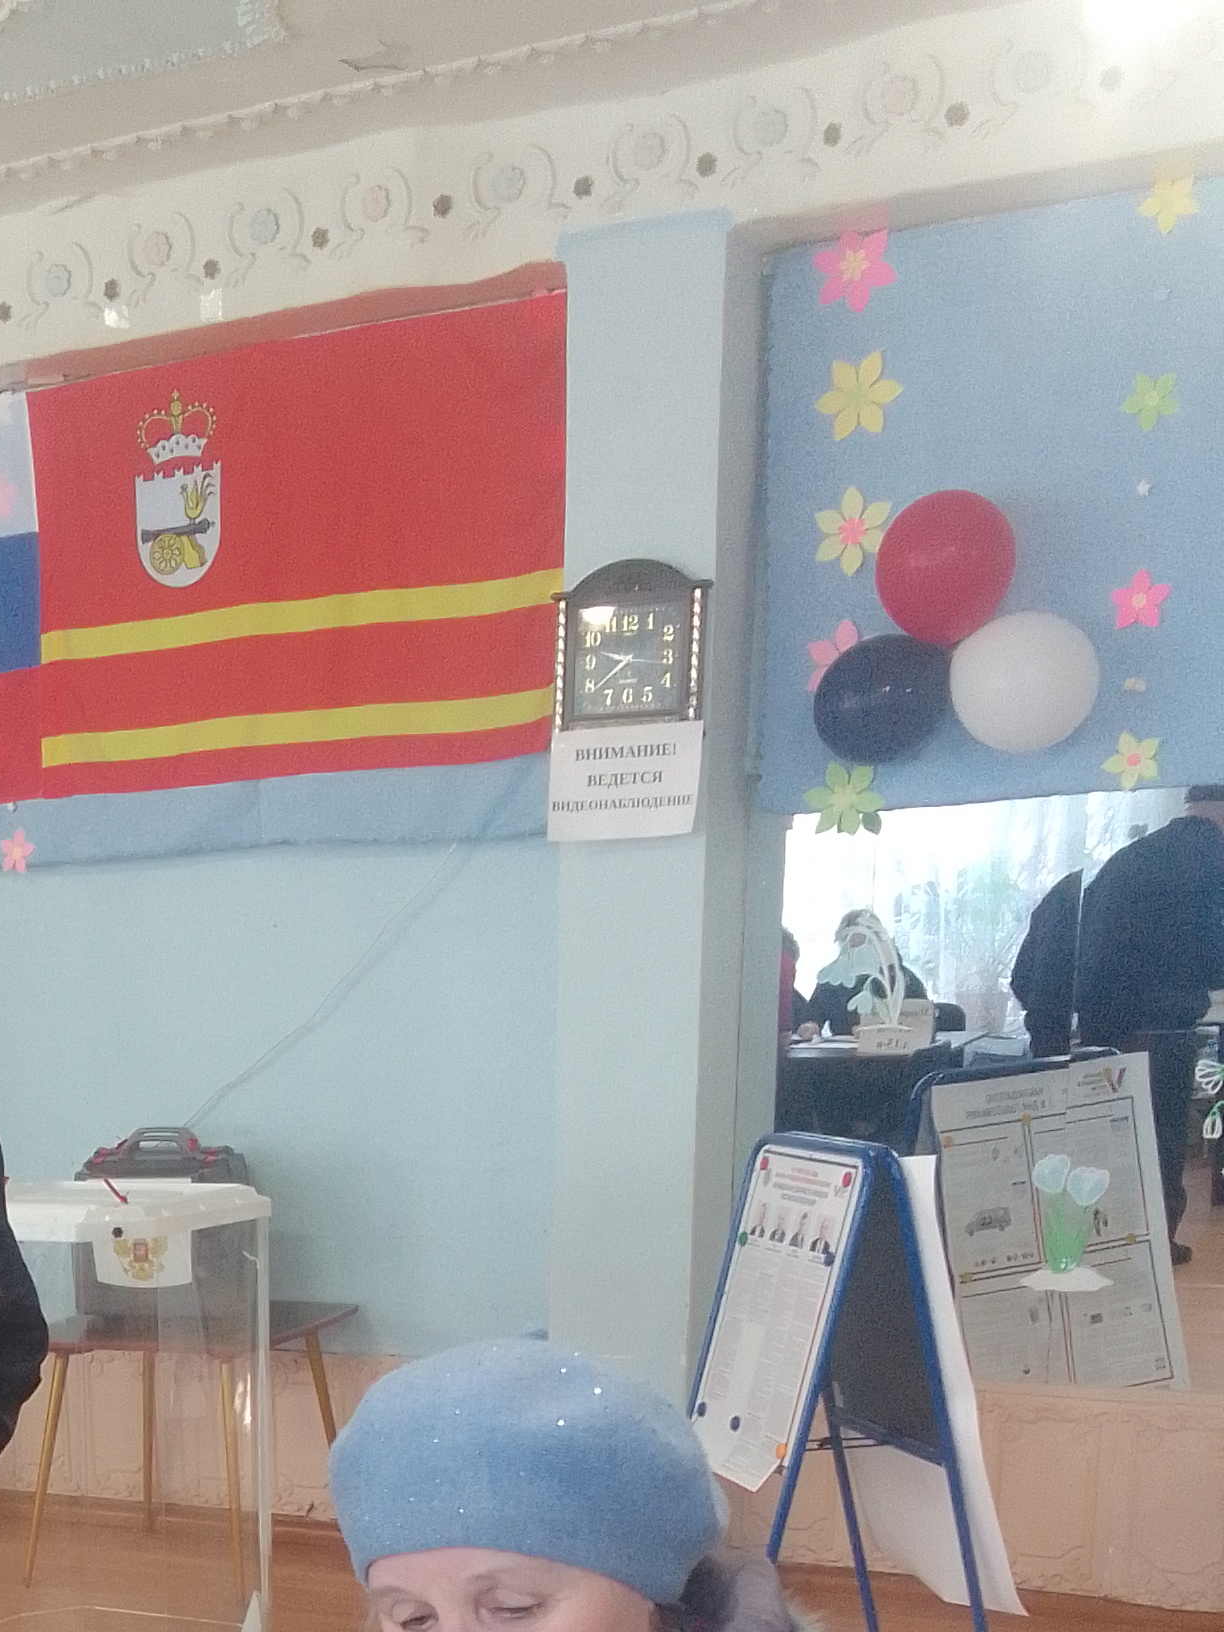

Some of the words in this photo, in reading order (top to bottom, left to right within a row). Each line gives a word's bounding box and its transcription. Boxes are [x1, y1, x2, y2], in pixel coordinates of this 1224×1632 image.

[622, 615, 639, 632] 12
[663, 624, 674, 641] 2
[663, 650, 673, 665] 3
[661, 672, 671, 688] 4
[603, 689, 614, 705] 7
[623, 688, 633, 704] 6
[642, 687, 653, 702] 5
[575, 742, 677, 762] ВНИМАНИЕ!
[587, 770, 663, 788] ВЕДЕТСЯ
[552, 794, 694, 813] ВИДЕОНАБЛЮДЕНИЕ
